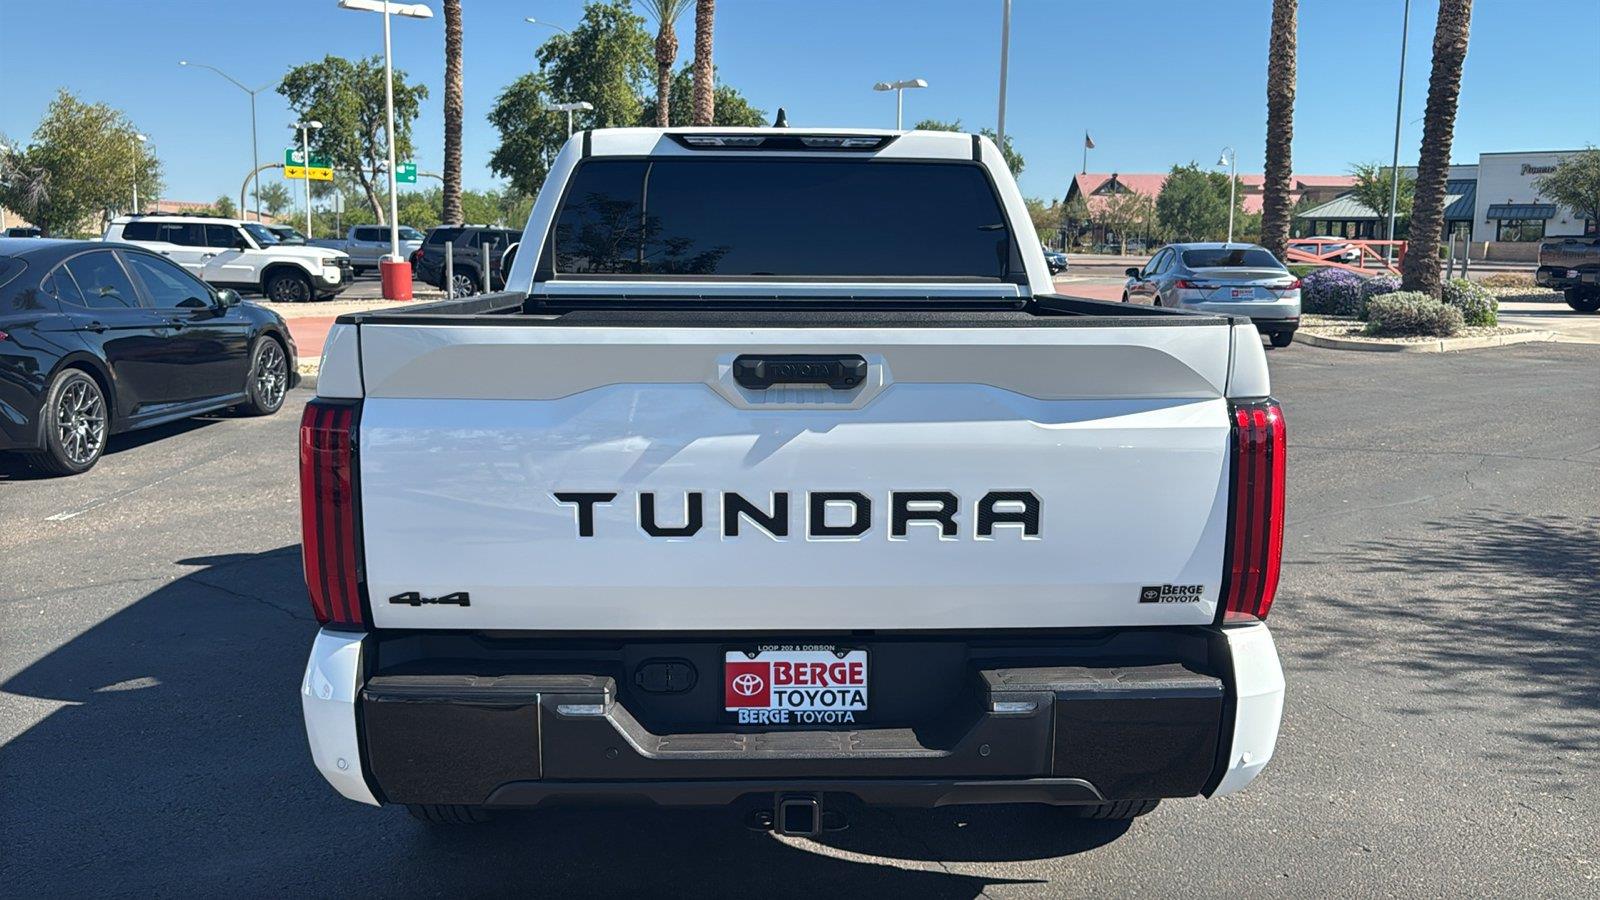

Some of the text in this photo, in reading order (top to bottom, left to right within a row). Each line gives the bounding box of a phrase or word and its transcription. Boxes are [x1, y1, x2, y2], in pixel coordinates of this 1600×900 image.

[552, 490, 1042, 538] TUNDRA
[1160, 595, 1201, 603] TOYOTA
[757, 644, 779, 652] LOOP
[781, 644, 794, 652] 202
[802, 644, 836, 652] DOBSON
[773, 661, 864, 688] BERGE
[774, 689, 867, 708] TOYOTA
[738, 708, 856, 725] BERGE TOYOTA
